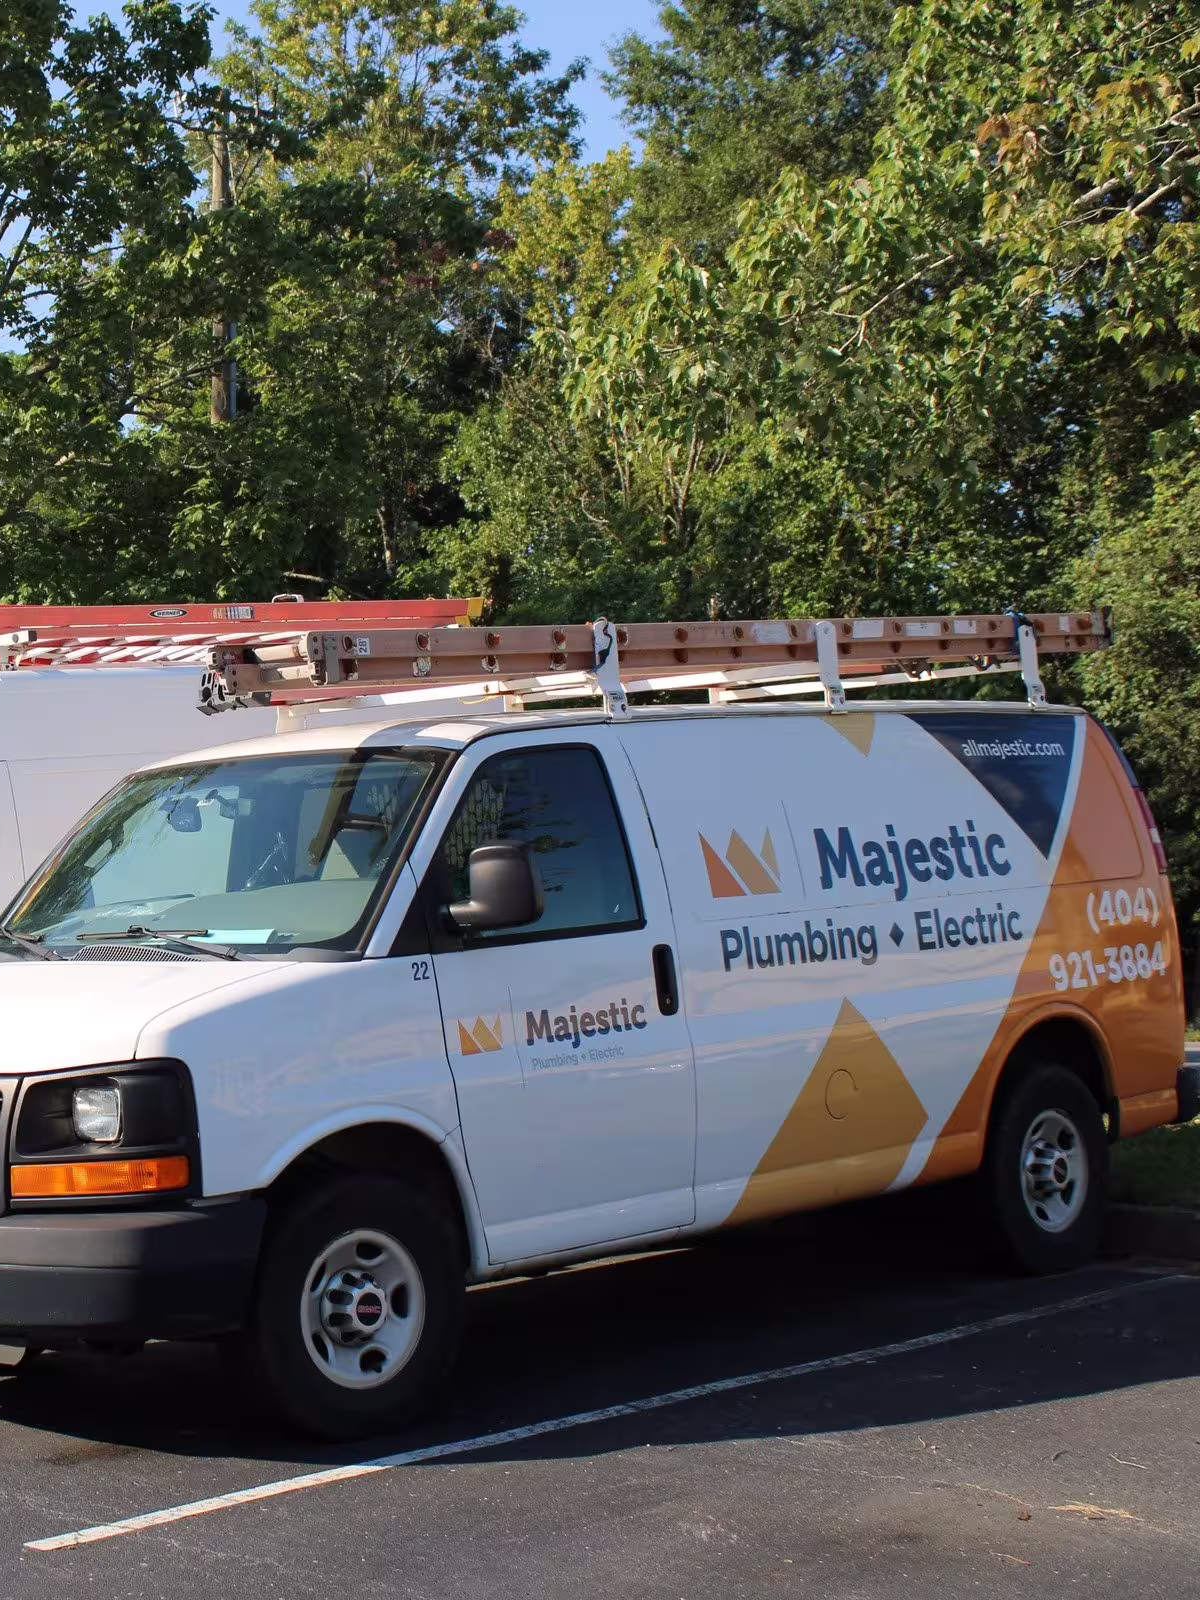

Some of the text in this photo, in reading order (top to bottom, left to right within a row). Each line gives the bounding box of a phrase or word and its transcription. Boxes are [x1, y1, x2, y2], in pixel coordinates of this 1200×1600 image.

[155, 609, 181, 617] WERNER
[961, 739, 1065, 759] allmajestic.com
[813, 819, 1011, 901] Majestic
[1086, 887, 1159, 934] (404)
[719, 902, 1022, 972] Plumbing Electric
[411, 961, 430, 981] 22
[1049, 941, 1166, 992] 921-3884
[526, 998, 648, 1049] Majestic
[531, 1045, 625, 1070] Plumbing Electric
